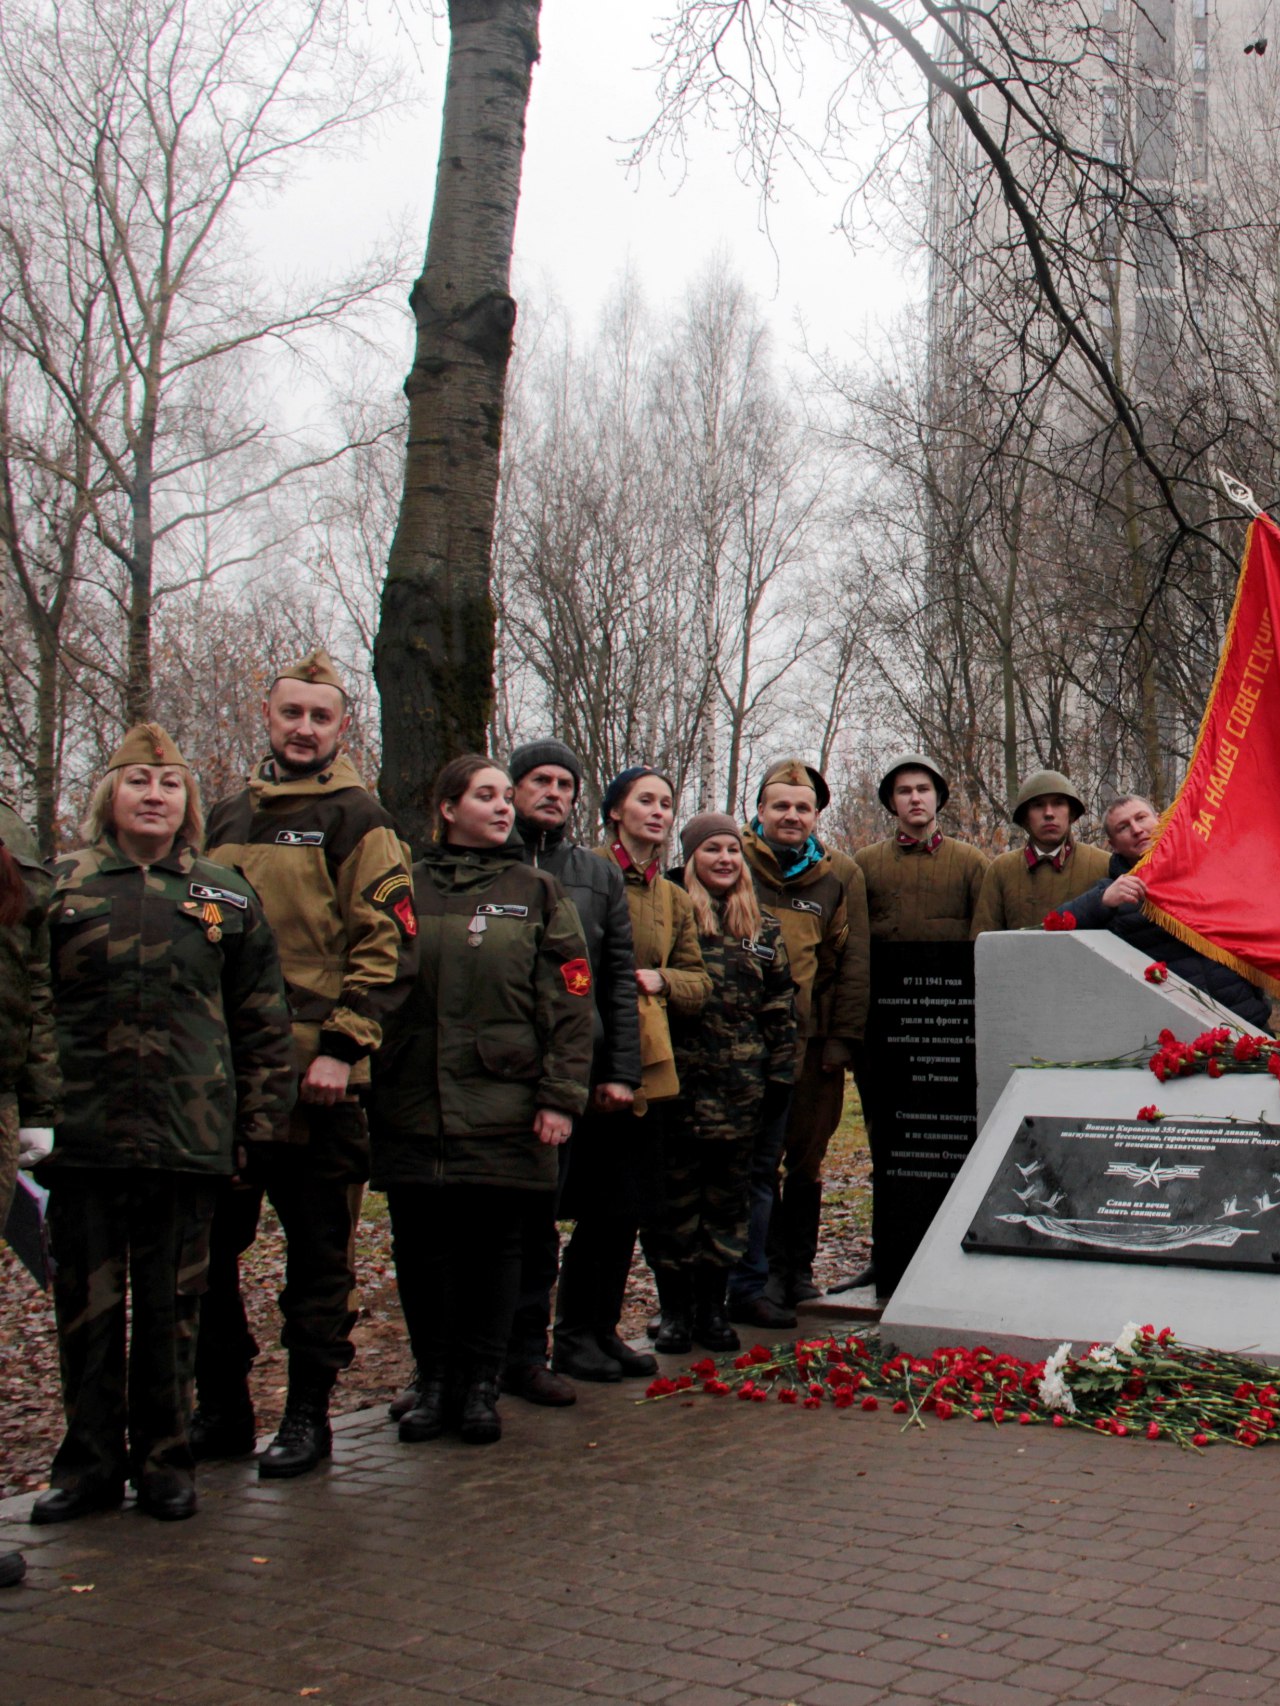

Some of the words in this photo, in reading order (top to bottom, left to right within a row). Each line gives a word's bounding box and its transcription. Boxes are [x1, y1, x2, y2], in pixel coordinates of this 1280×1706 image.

[1192, 809, 1216, 842] ЗА
[1204, 737, 1240, 809] НАШУ
[925, 976, 943, 986] 1941
[944, 978, 963, 987] года
[877, 997, 911, 1005] солдаты
[919, 996, 956, 1007] офицеры
[900, 1017, 923, 1026] ушли
[924, 1017, 934, 1025] на
[935, 1015, 961, 1026] фронт
[887, 1034, 920, 1043] погибли
[931, 1036, 964, 1044] полгода
[916, 1055, 961, 1065] окружении
[912, 1074, 927, 1082] под
[928, 1073, 959, 1083] Ржевом
[895, 1110, 938, 1121] Стоявшим
[1085, 1123, 1116, 1131] Воинам
[1116, 1124, 1160, 1133] Кировской
[1177, 1127, 1224, 1136] стрелковой
[912, 1132, 922, 1140] не
[923, 1132, 969, 1141] сдавшимся
[1060, 1131, 1108, 1140] шагнувшим
[1163, 1135, 1210, 1143] героически
[1125, 1141, 1164, 1149] немецких
[1164, 1143, 1216, 1151] захватчиков
[890, 1150, 941, 1159] защитникам
[897, 1167, 949, 1180] благодарных
[1106, 1198, 1132, 1208] Слава
[1145, 1202, 1170, 1210] вечна
[1097, 1206, 1129, 1216] Память
[1130, 1209, 1171, 1218] священна
